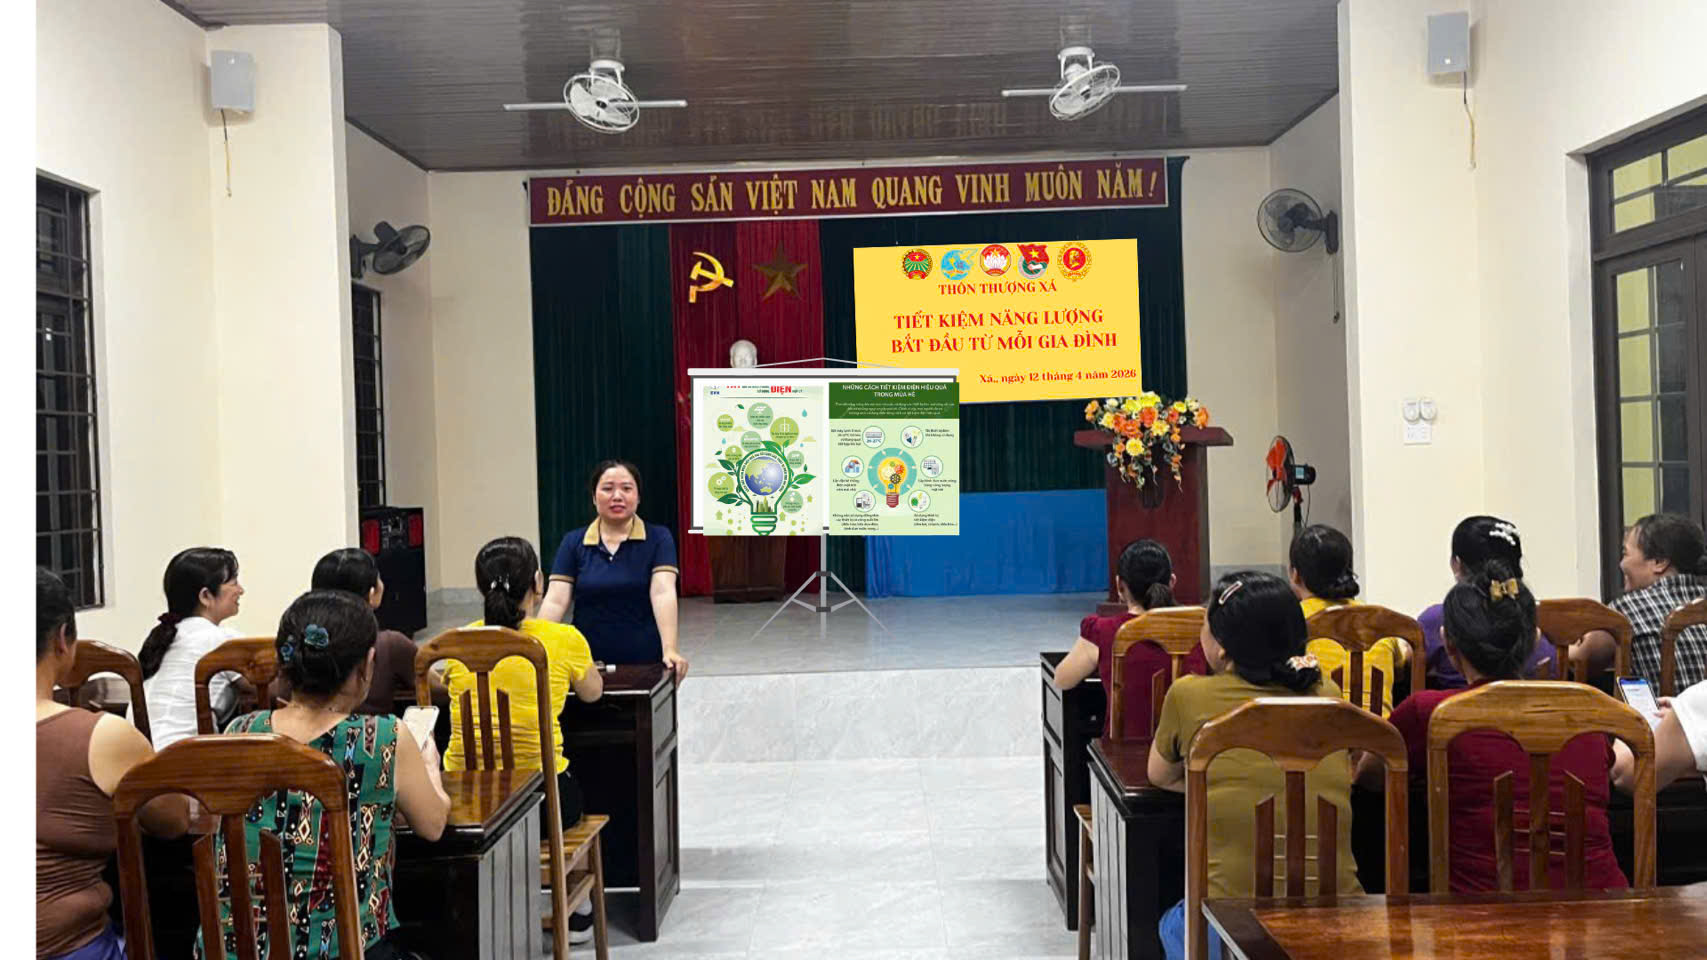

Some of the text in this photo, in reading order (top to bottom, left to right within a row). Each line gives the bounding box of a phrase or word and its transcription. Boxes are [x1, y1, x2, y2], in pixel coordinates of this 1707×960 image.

[547, 179, 604, 216] ĐẢNG
[619, 177, 677, 218] CỘNG
[691, 175, 733, 212] SẢN
[745, 174, 798, 215] VIỆT
[811, 177, 857, 210] NAM
[871, 175, 943, 210] QUANG
[955, 172, 1010, 204] VINH
[1025, 164, 1083, 201] MUÔN
[938, 281, 976, 296] THÔN
[979, 280, 1036, 295] THƯỢNG
[893, 307, 1103, 329] TIẾT KIỆM NĂNG LƯỢNG
[891, 329, 1117, 354] BẮT ĐẦU TỪ MỖI GIA ĐÌNH
[1001, 373, 1025, 385] ngày
[1029, 372, 1040, 382] 12
[1041, 371, 1074, 382] tháng
[1075, 371, 1083, 380] 4
[1110, 368, 1137, 379] 2026
